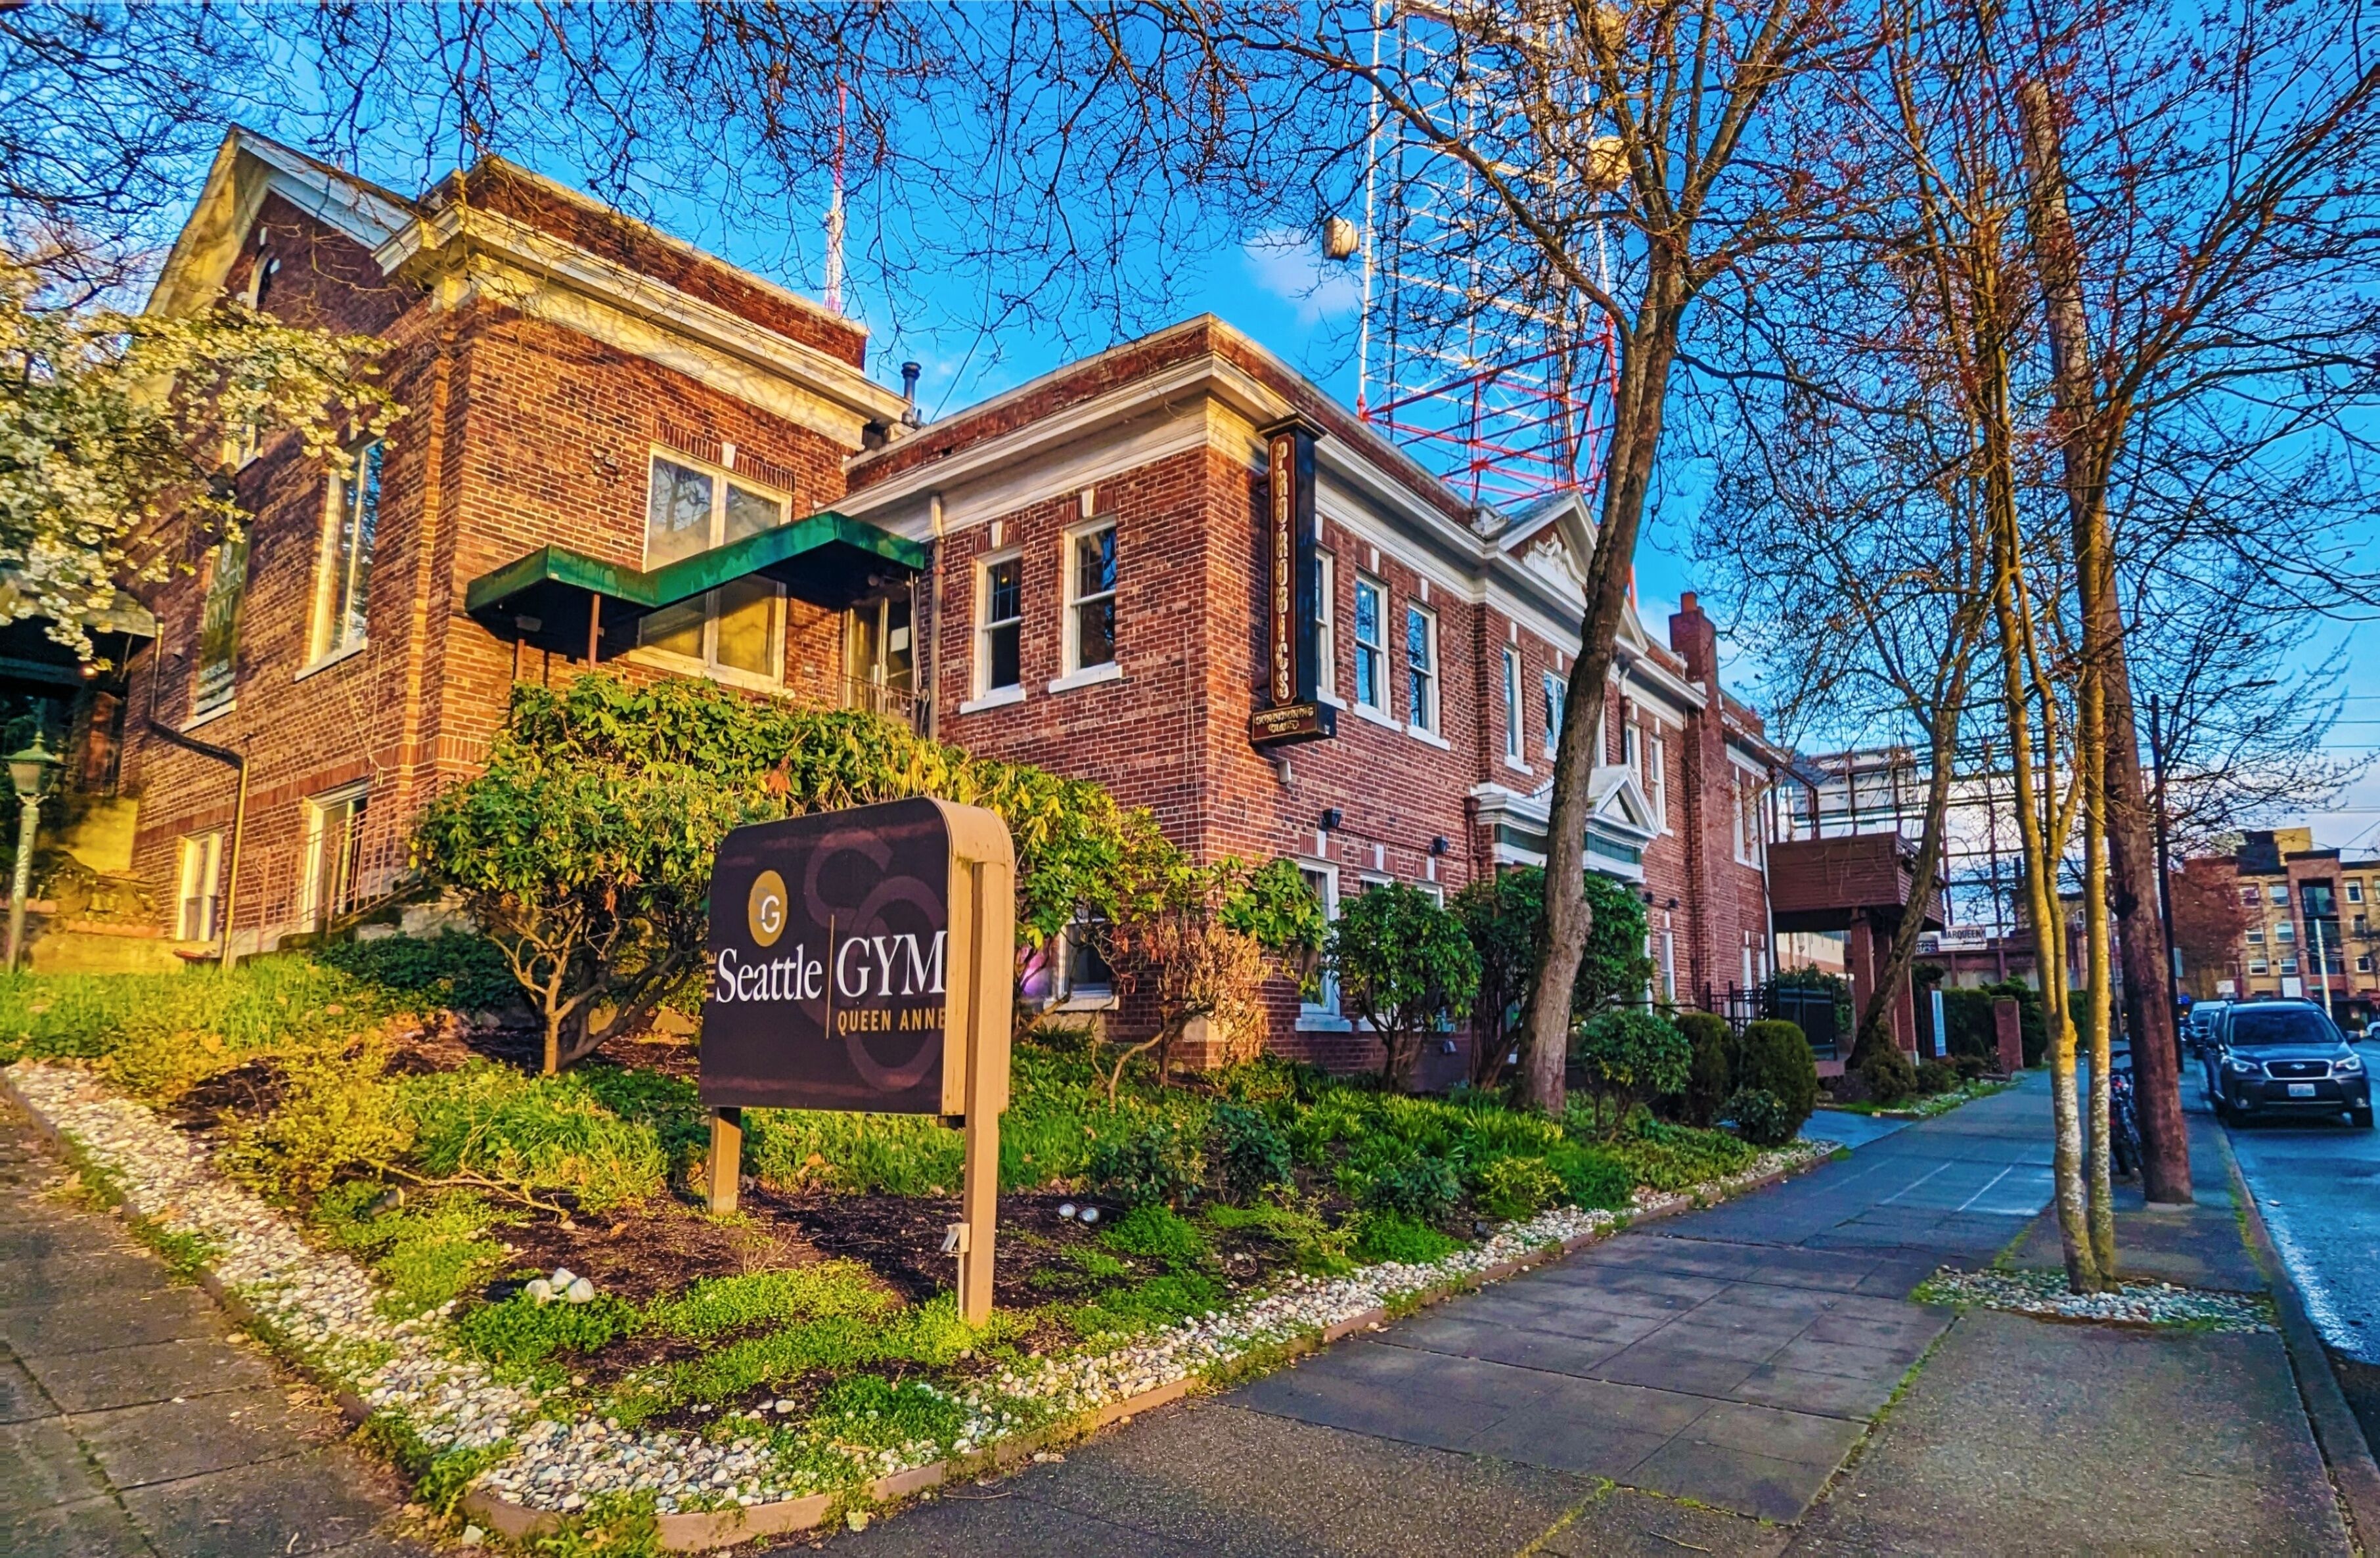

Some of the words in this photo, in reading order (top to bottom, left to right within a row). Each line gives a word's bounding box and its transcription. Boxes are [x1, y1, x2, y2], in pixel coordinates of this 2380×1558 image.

[704, 951, 717, 1000] THE
[716, 943, 822, 1003] Seattle
[837, 930, 948, 998] GYM
[838, 1009, 891, 1036] QUEEN
[899, 1007, 945, 1031] ANNE
